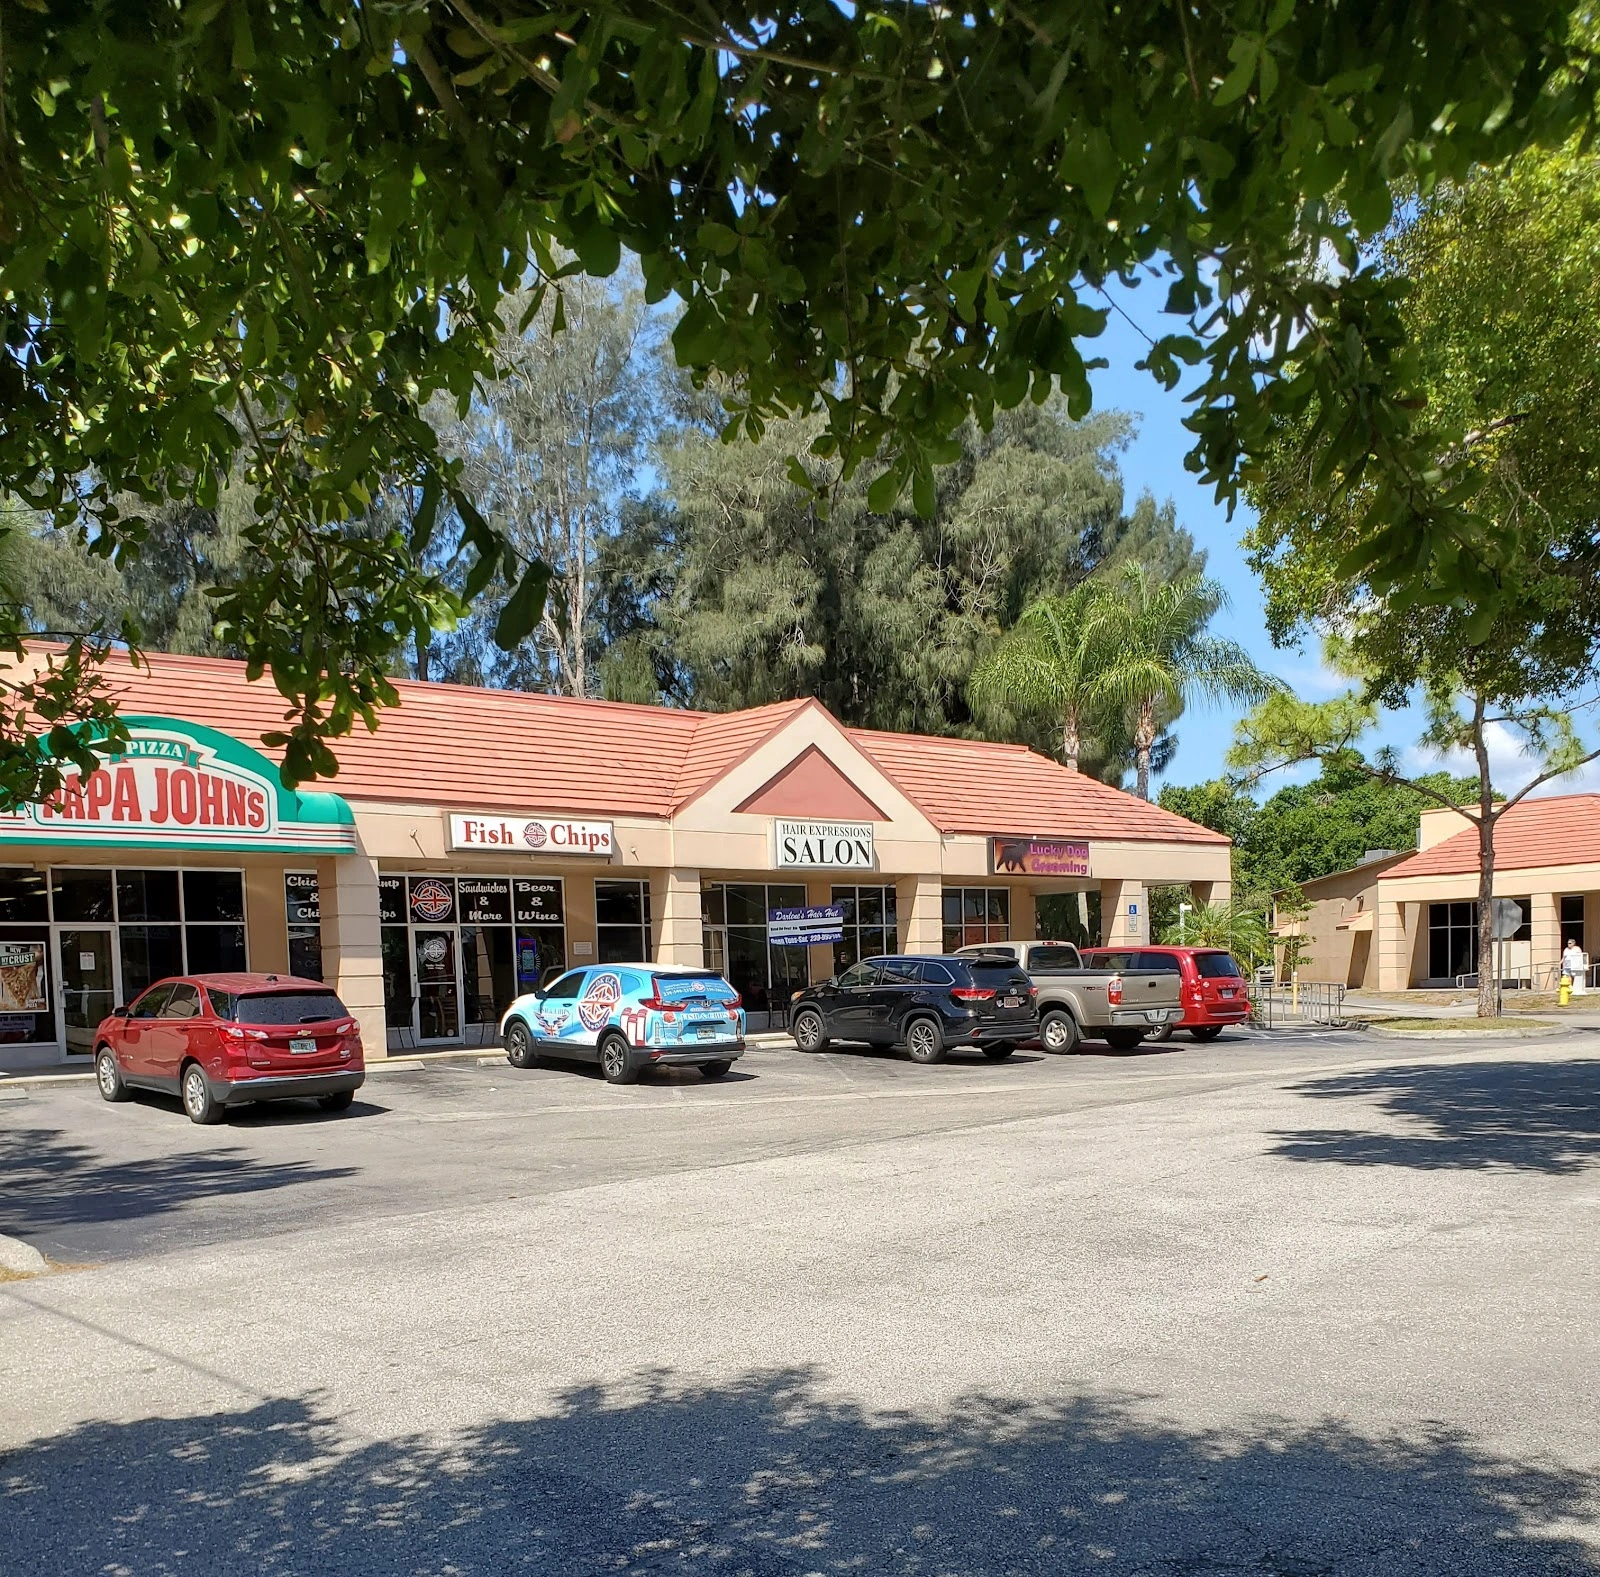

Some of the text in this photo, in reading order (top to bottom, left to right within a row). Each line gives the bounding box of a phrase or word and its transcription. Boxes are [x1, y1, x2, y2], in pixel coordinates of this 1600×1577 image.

[125, 740, 183, 758] PIZZA
[149, 767, 264, 828] JOHN'S
[463, 820, 610, 852] Fish Chips
[782, 824, 872, 838] HAIR EXPRESSIONS
[783, 837, 872, 865] SALON
[1029, 843, 1088, 859] Lucky Dog
[1031, 859, 1088, 875] Grooming
[286, 876, 319, 887] Chic
[458, 881, 508, 894] Sandwiches
[515, 882, 556, 892] Beer
[479, 896, 489, 906] &
[530, 896, 543, 906] &
[296, 907, 321, 919] Chi
[468, 911, 503, 920] More
[517, 911, 559, 920] Wine
[775, 908, 839, 920] Darlene's Hair Hut
[9, 946, 21, 954] NEW
[9, 953, 35, 965] CRUST
